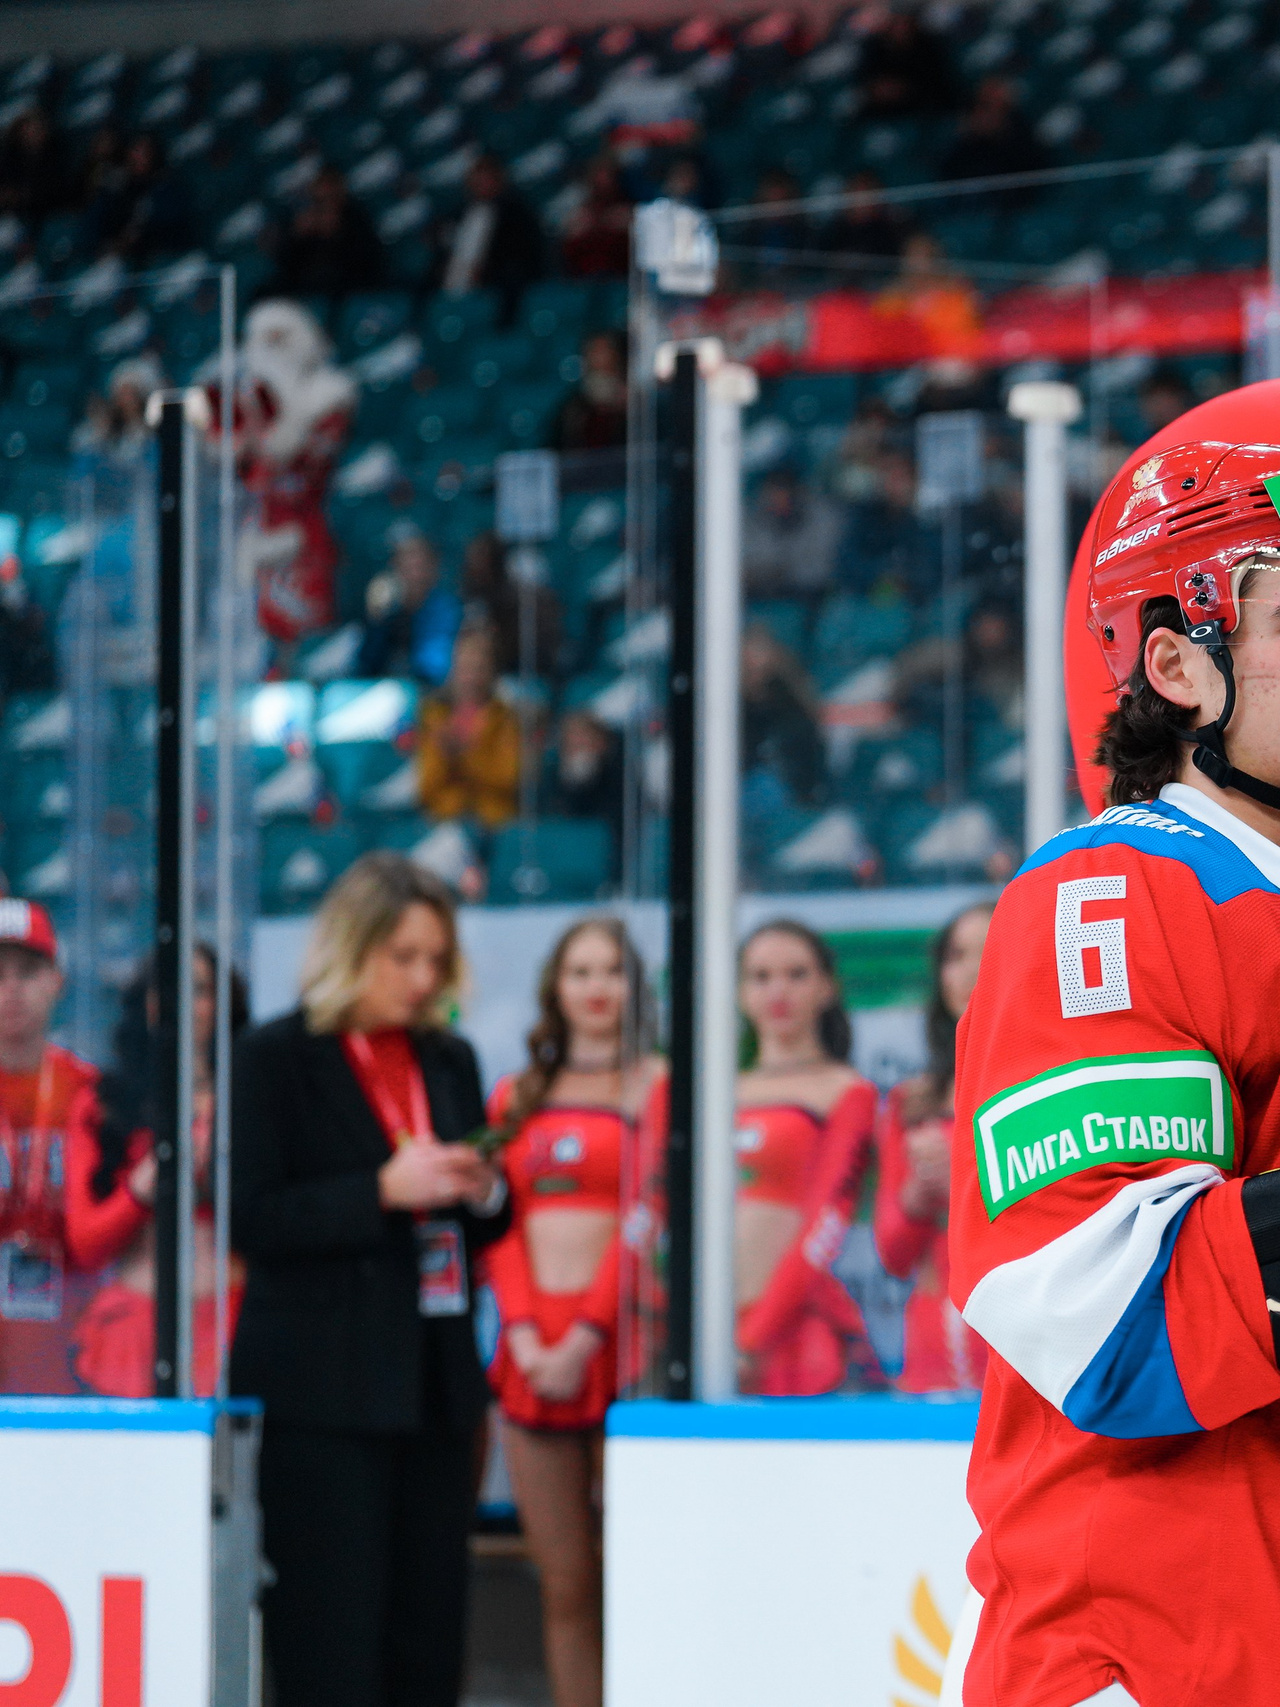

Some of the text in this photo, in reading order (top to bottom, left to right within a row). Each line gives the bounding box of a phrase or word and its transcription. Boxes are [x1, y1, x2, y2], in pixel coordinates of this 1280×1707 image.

[1055, 875, 1132, 1019] 6
[1006, 1112, 1208, 1191] ЛИГА СТАВОК
